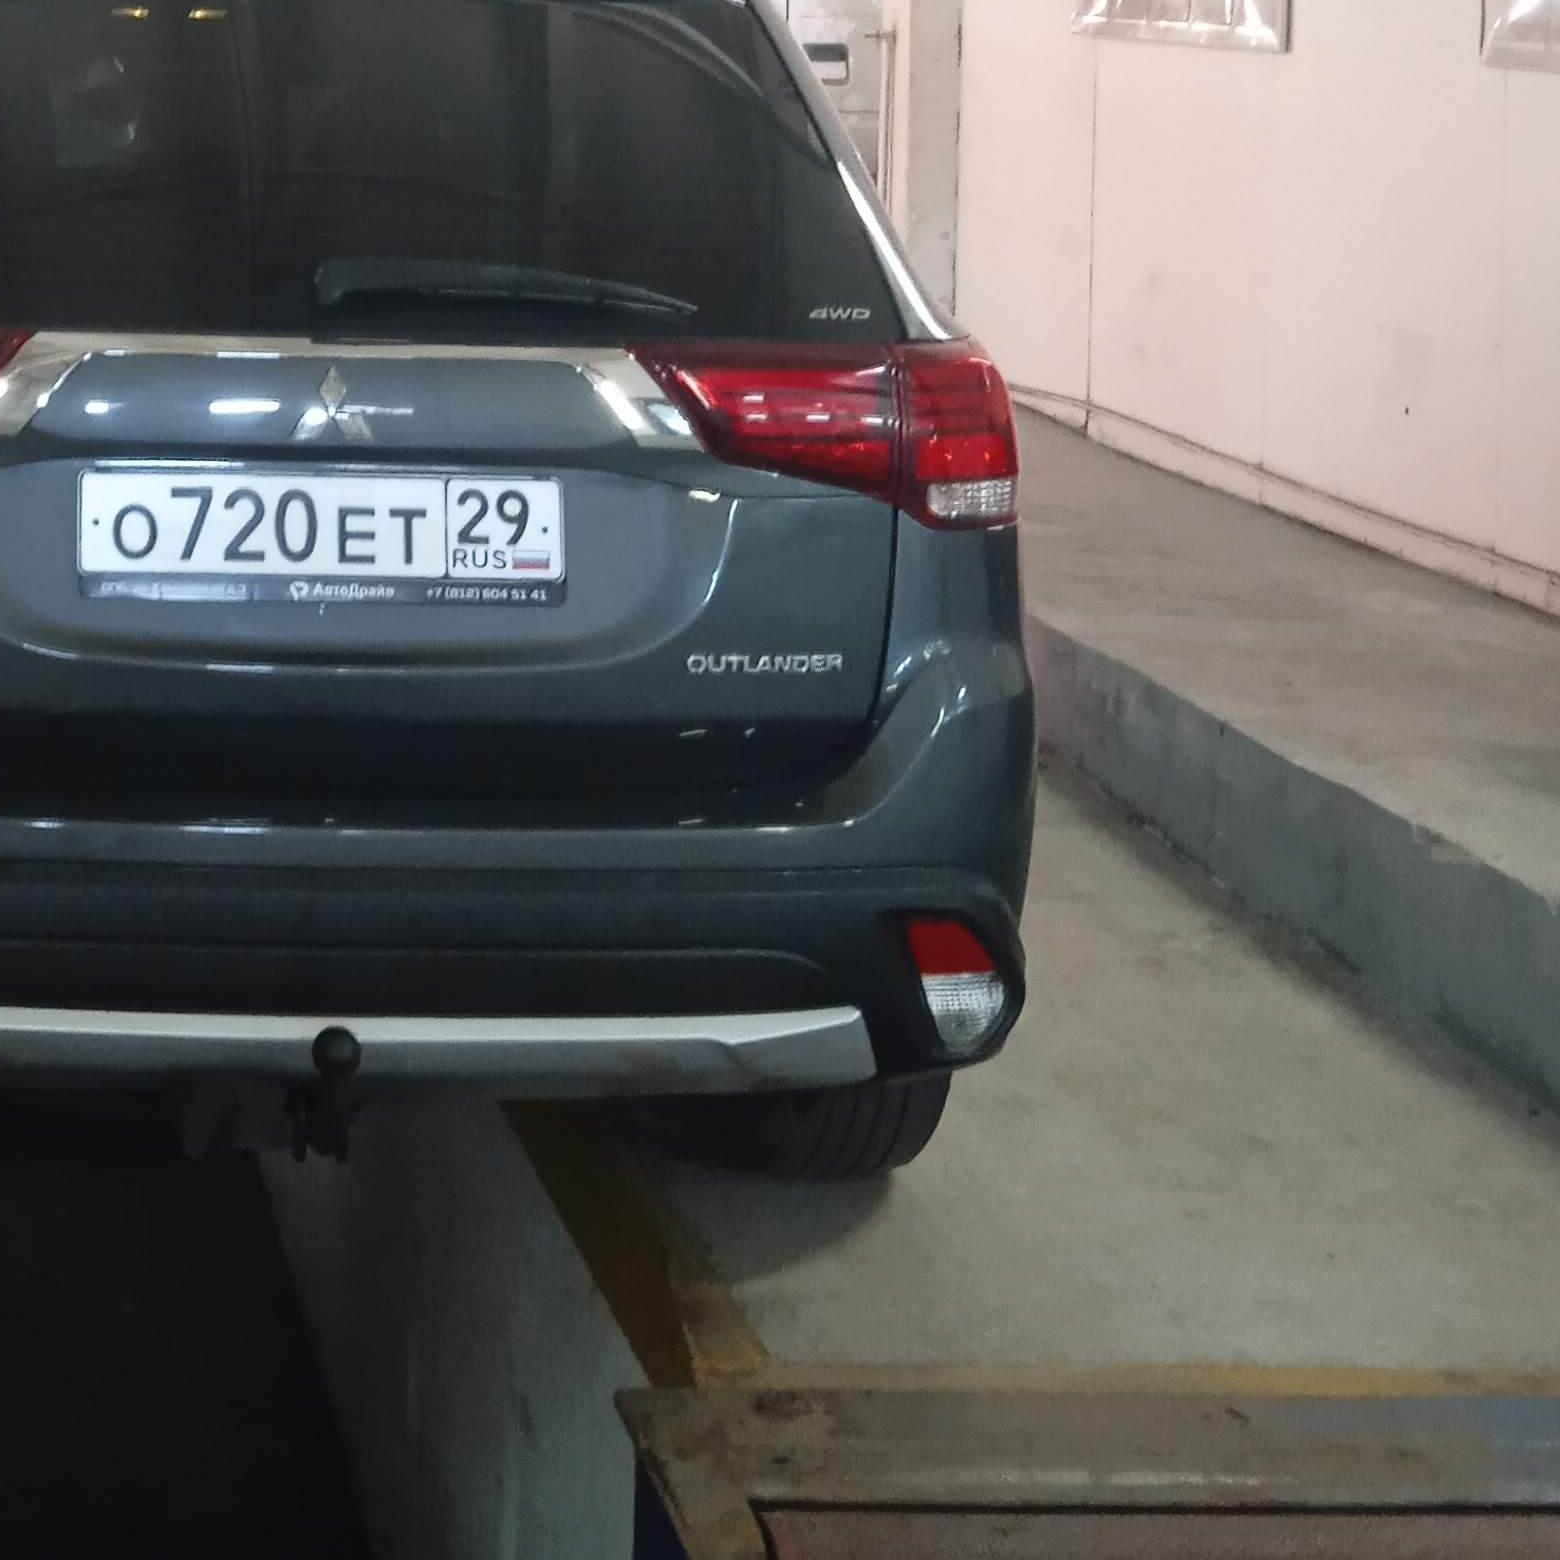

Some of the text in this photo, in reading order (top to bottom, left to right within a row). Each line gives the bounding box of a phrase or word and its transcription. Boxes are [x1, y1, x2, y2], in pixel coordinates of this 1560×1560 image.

[809, 307, 871, 320] 4WD
[456, 488, 530, 546] 29
[452, 549, 507, 570] RUS
[530, 589, 547, 601] 41
[686, 653, 844, 673] OUTLANDER
